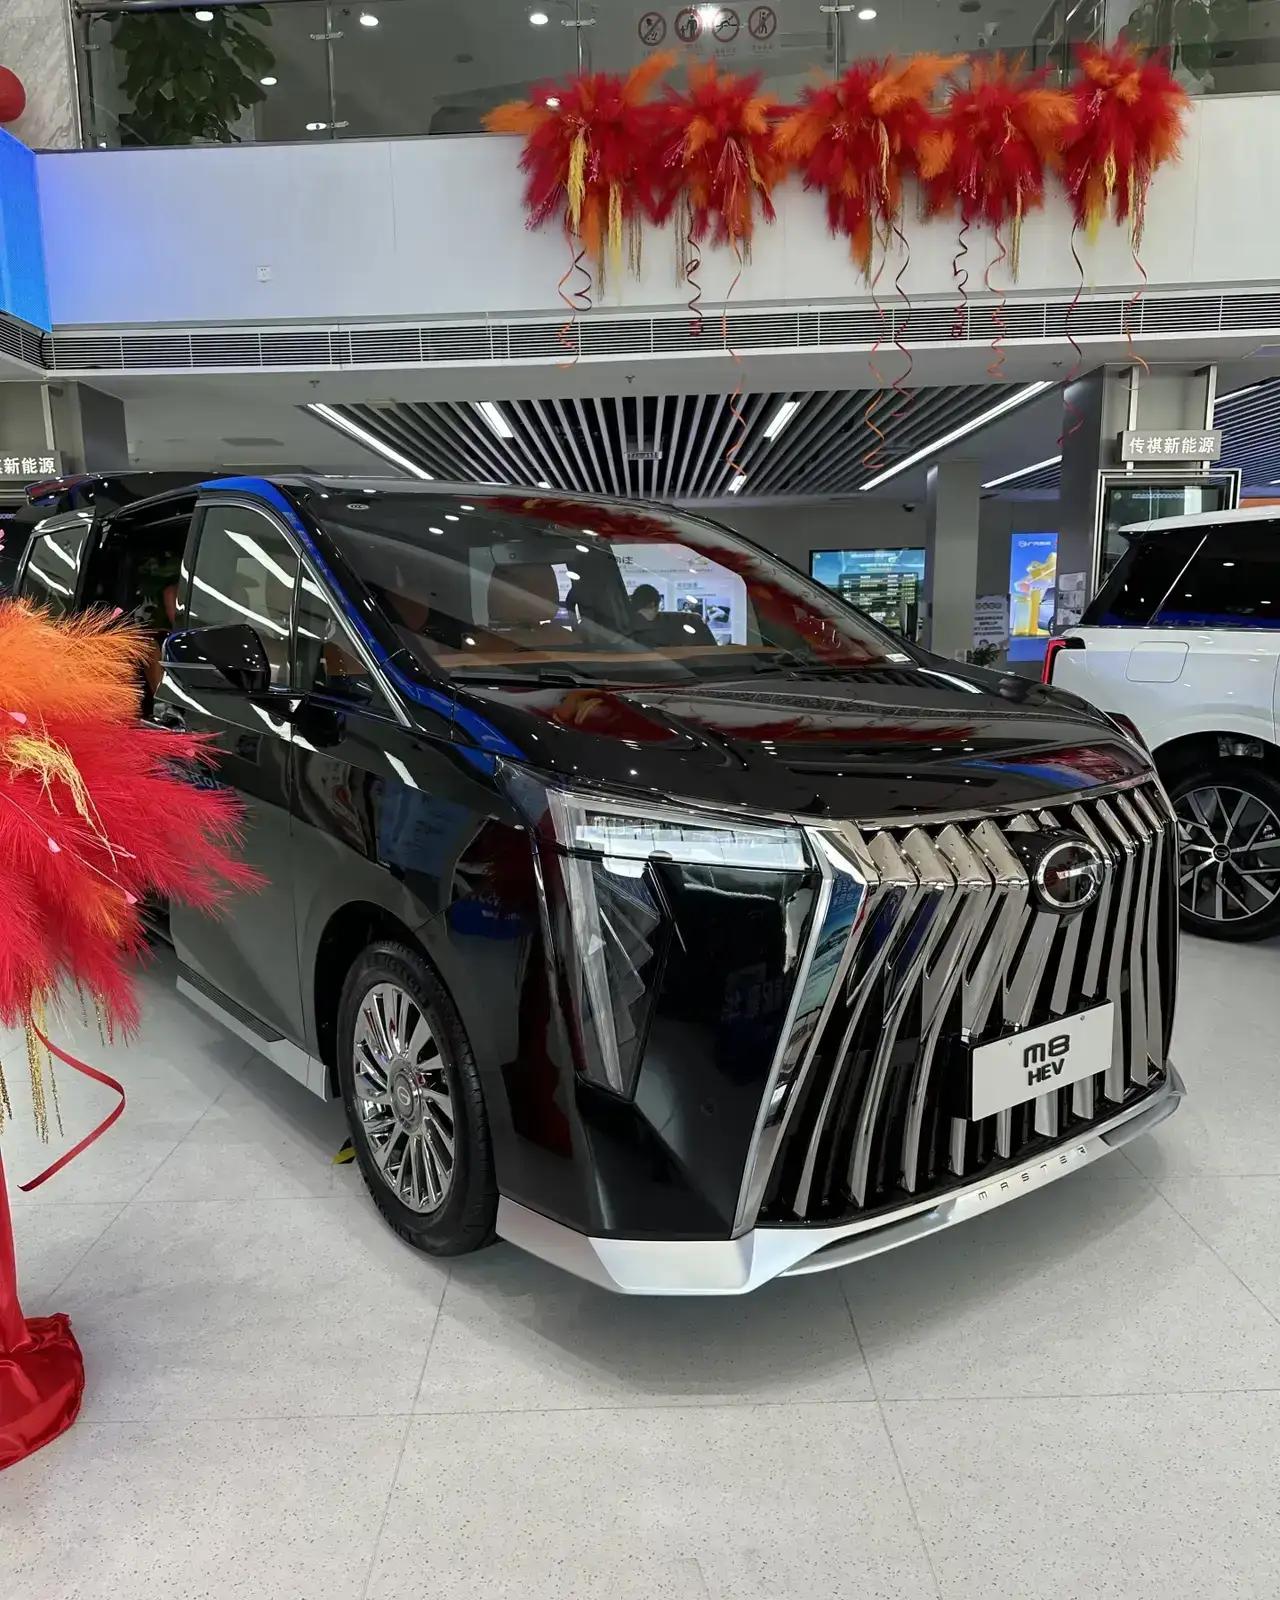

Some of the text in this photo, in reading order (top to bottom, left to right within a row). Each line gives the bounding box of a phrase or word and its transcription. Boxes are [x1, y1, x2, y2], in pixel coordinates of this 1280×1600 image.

[1129, 436, 1215, 454] 传祺新能源
[0, 457, 56, 475] 新能源
[1023, 1034, 1070, 1068] M8
[1028, 1058, 1065, 1086] HEV
[978, 1145, 1087, 1201] MASTER
